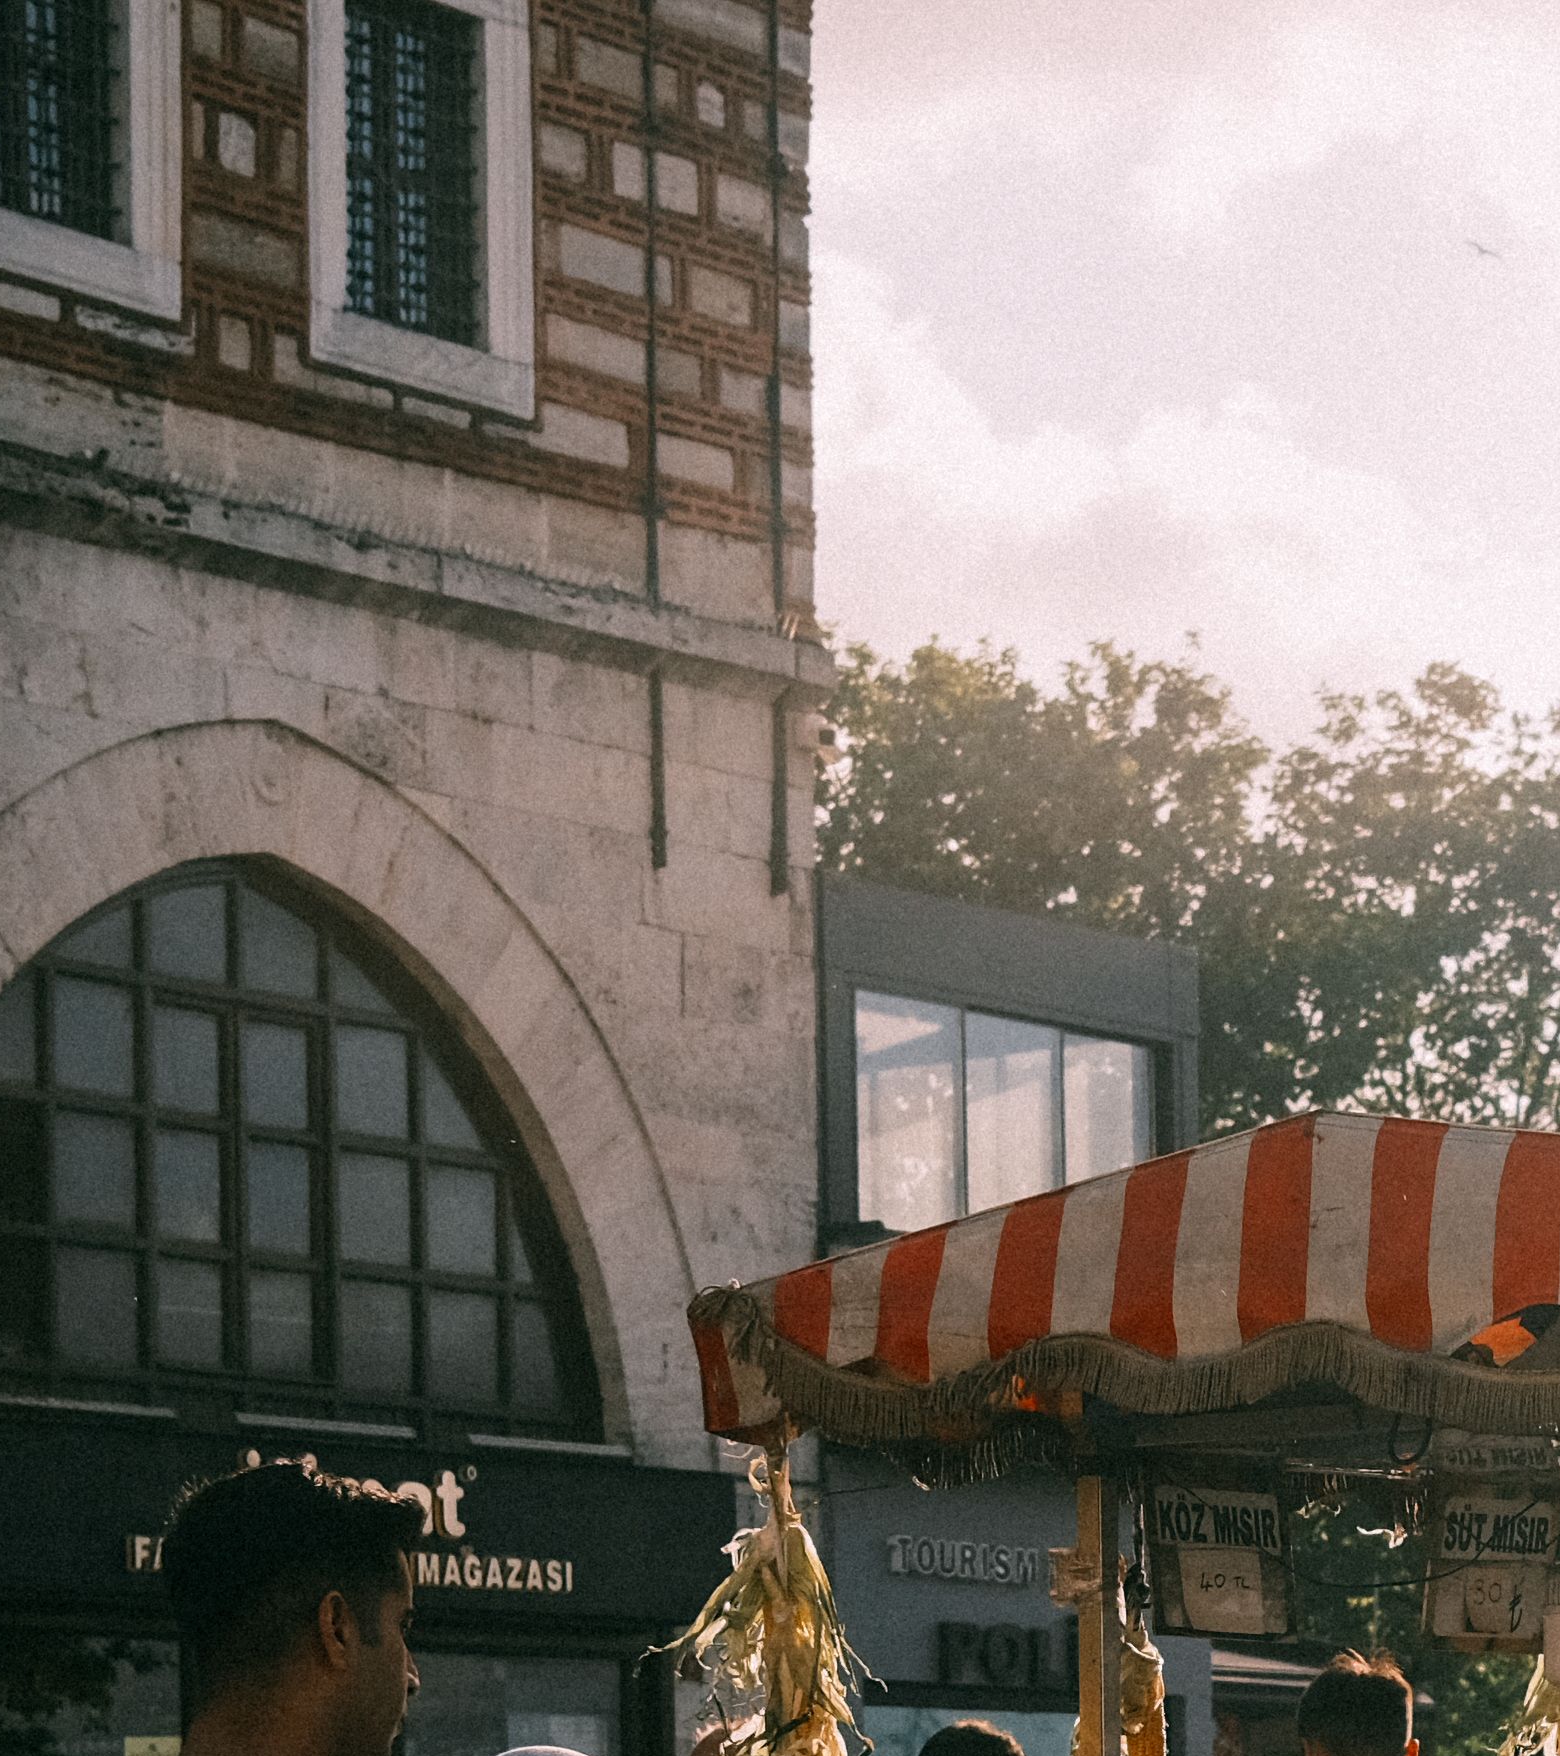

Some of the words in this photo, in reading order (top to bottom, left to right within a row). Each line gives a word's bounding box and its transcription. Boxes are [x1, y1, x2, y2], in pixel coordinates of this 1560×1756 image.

[1157, 1493, 1208, 1544] KÖZ
[1443, 1503, 1487, 1552] SÜT
[1491, 1513, 1549, 1555] MISIR
[415, 1545, 574, 1593] MAĞAZASI
[887, 1534, 1041, 1585] TOURISM
[1199, 1572, 1226, 1592] 40
[1233, 1575, 1250, 1589] TL
